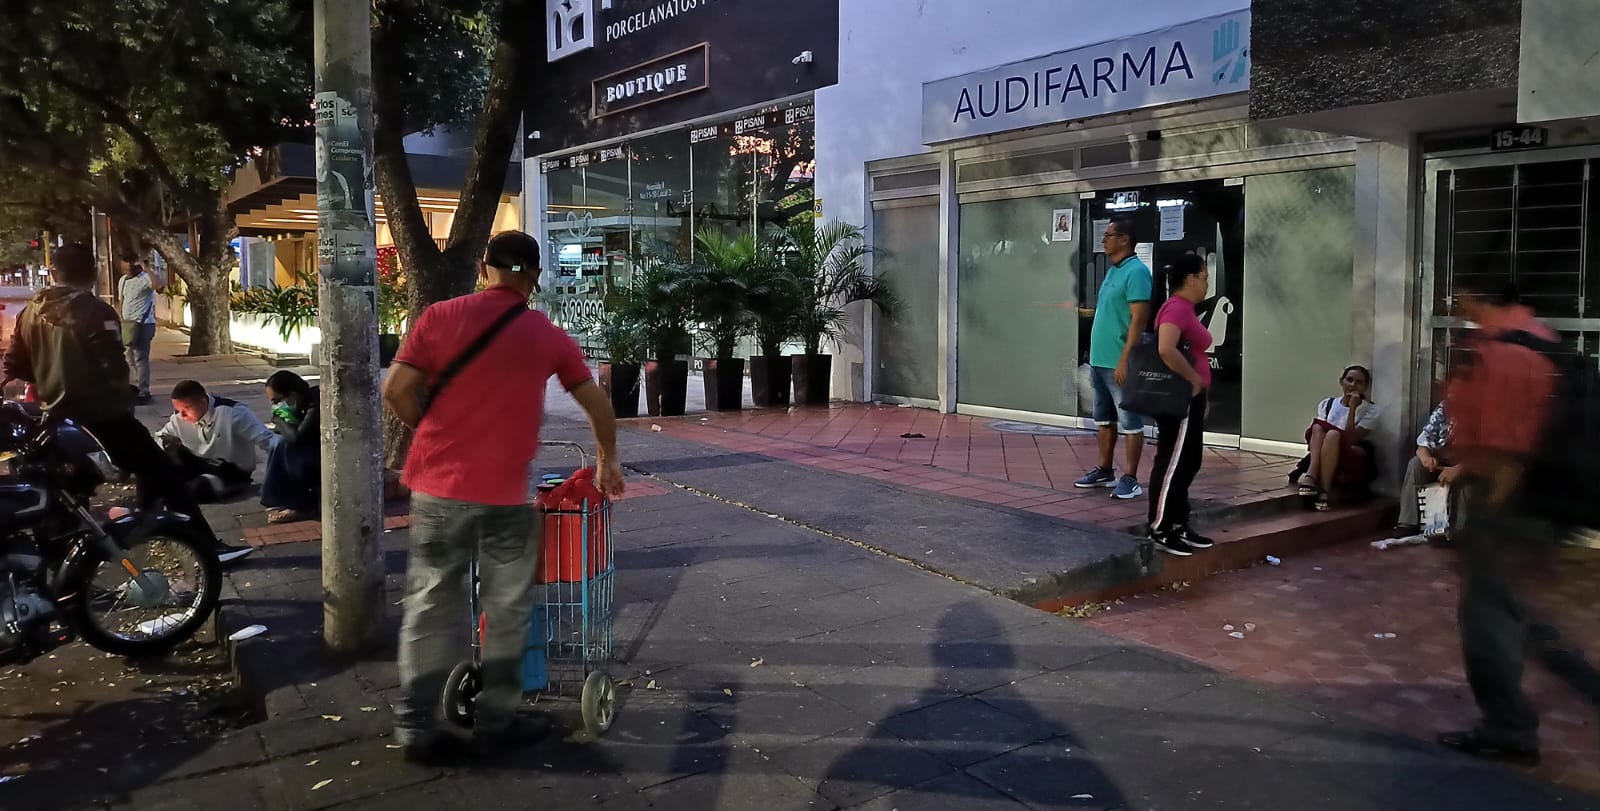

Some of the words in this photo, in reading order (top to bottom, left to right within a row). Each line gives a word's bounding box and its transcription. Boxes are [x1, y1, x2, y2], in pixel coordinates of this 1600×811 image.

[606, 0, 698, 42] PORCELANATOS
[606, 64, 687, 103] BOUTIQUE
[953, 41, 1194, 124] AUDIFARMA
[795, 104, 815, 118] PISAN
[743, 116, 765, 129] PISANI
[698, 126, 718, 138] PISANI
[1493, 128, 1542, 148] 15-44
[606, 146, 622, 157] PISANI
[575, 154, 590, 164] PISANI
